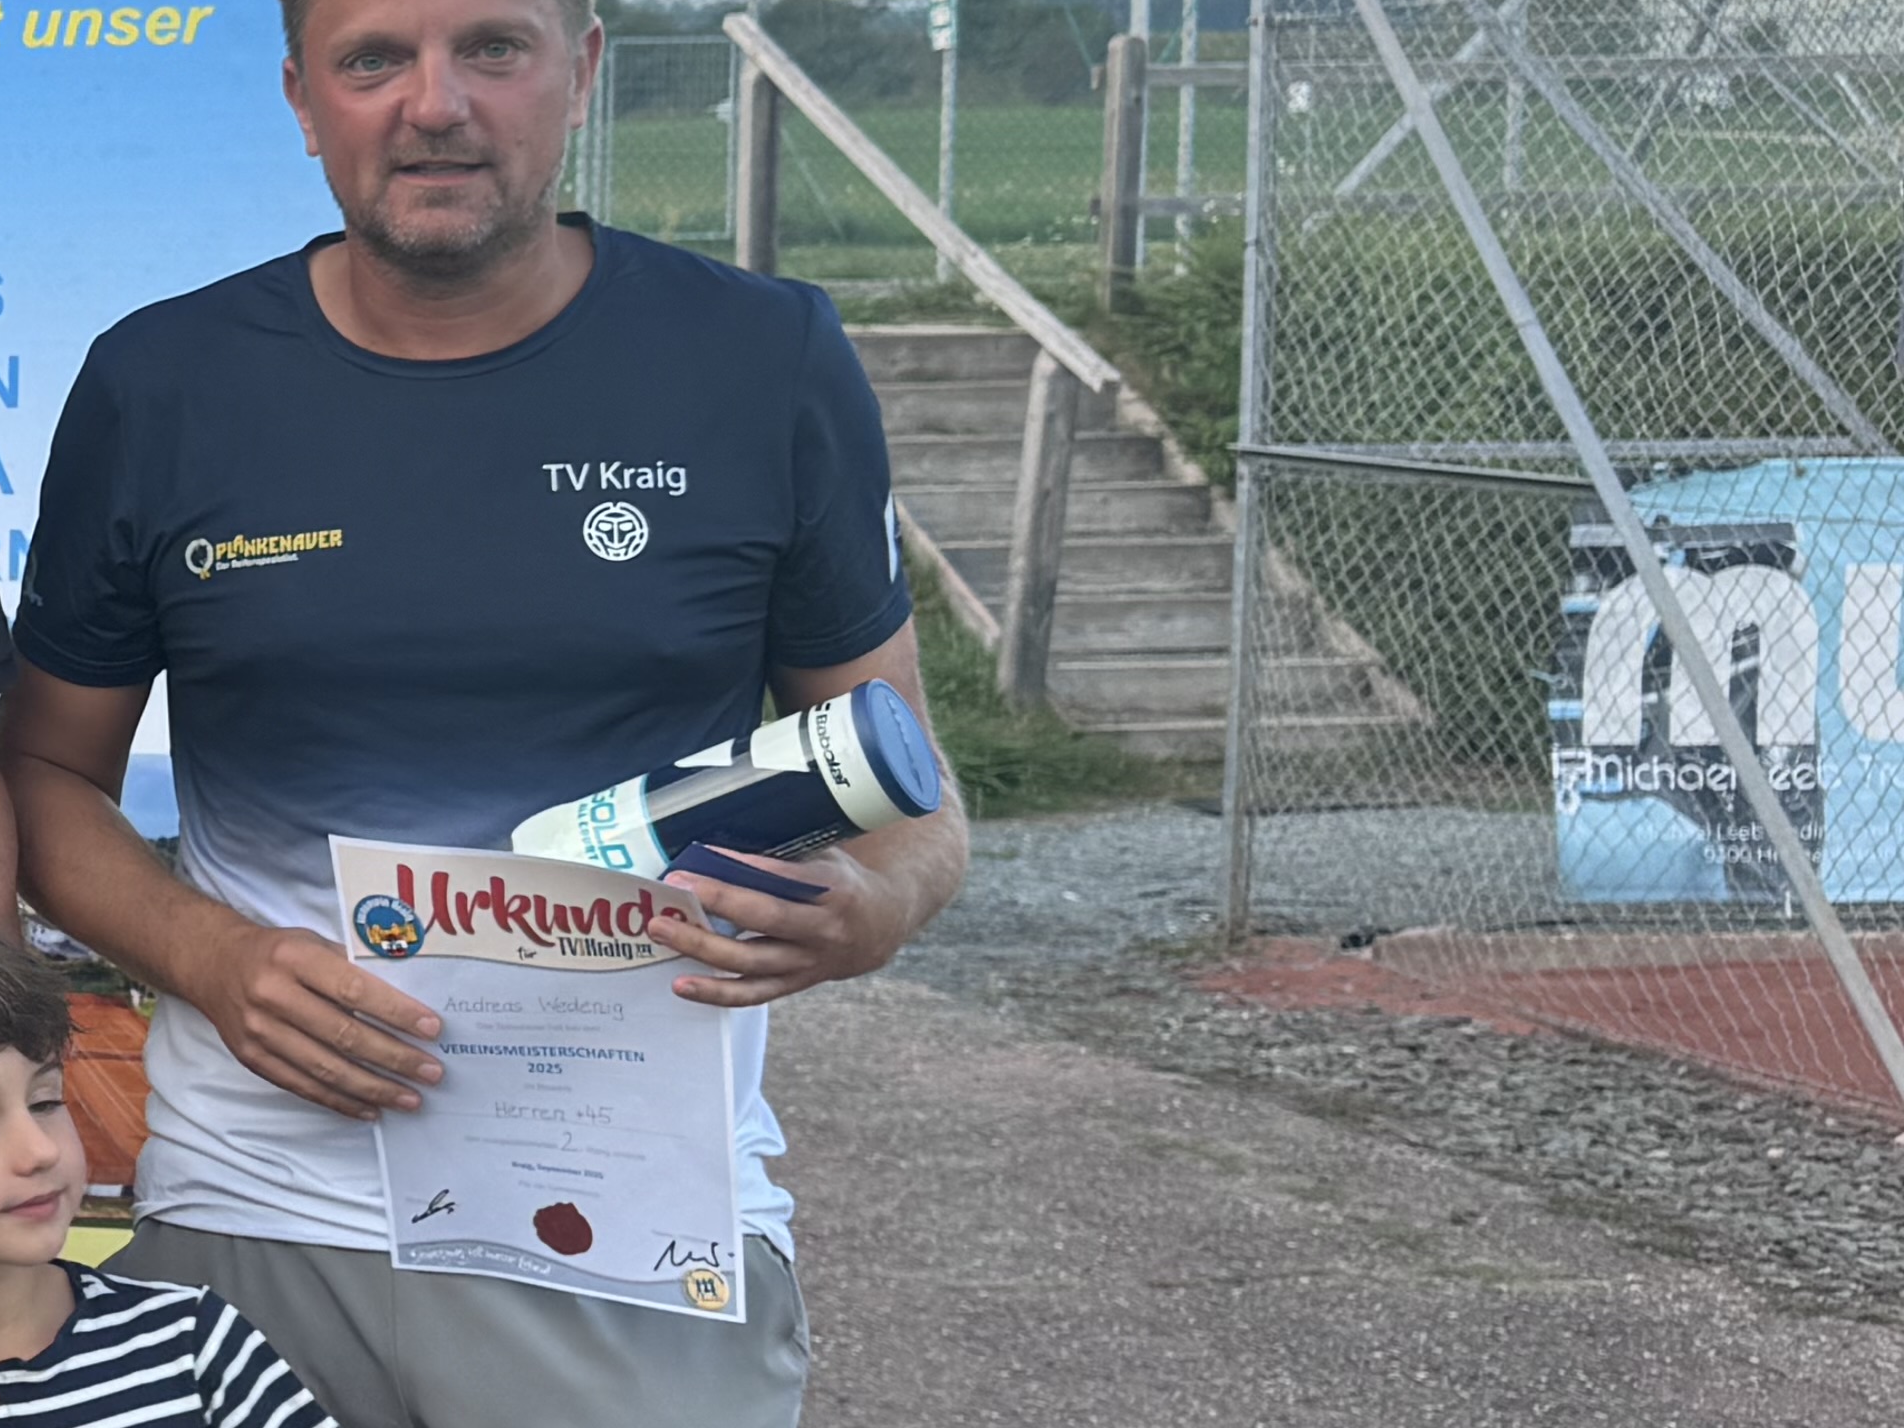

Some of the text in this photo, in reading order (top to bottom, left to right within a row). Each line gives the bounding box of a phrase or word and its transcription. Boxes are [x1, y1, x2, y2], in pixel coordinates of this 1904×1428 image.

[21, 4, 214, 49] unser
[542, 460, 687, 496] TV Kraig
[443, 996, 523, 1015] Andreas
[439, 1042, 645, 1063] VEREINSMEISTERSCHAFTEN
[527, 1061, 563, 1074] 2025
[495, 1101, 566, 1122] Herren
